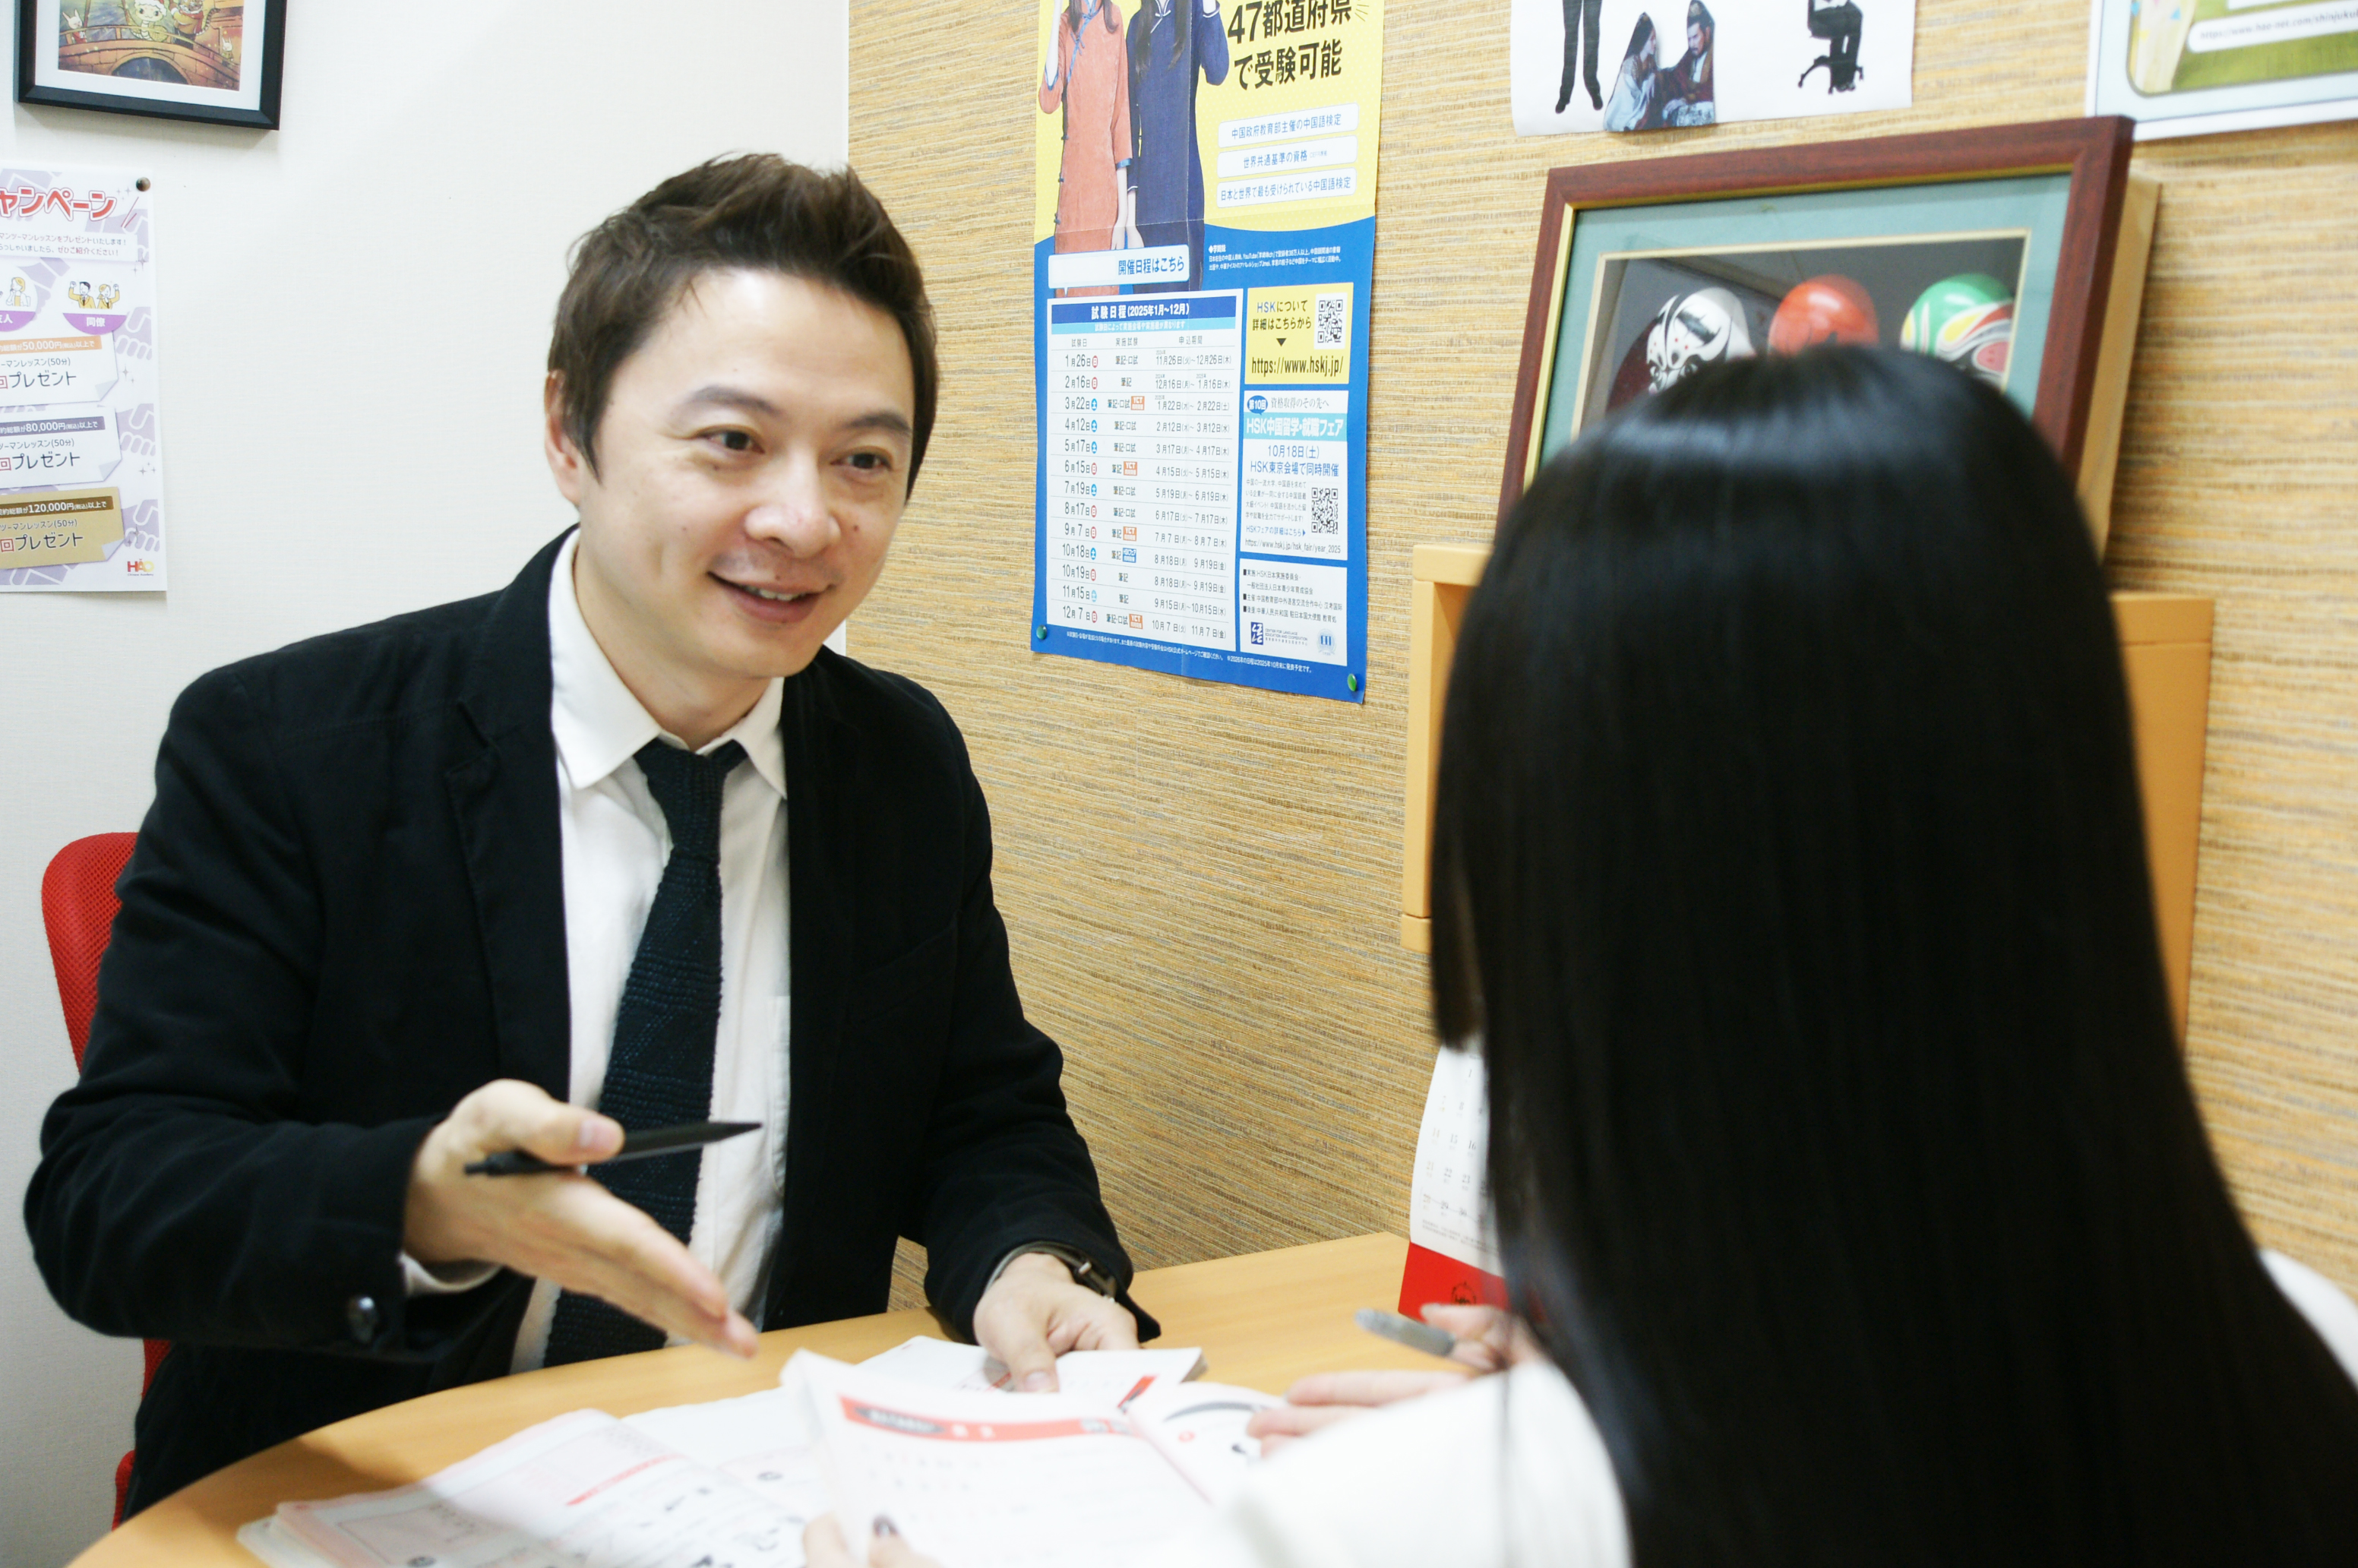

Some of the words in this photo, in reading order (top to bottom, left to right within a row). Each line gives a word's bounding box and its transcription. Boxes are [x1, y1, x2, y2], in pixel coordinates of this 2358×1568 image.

[1228, 0, 1351, 43] 47都道府県
[1234, 39, 1342, 90] で受験可能
[1232, 114, 1342, 139] 中国政府教育部主催の中国語検定
[1244, 150, 1307, 169] 世界共通基準の資格
[1222, 177, 1351, 201] 日本と世界で最も受けられている中国語検定
[1118, 256, 1184, 275] 開催日程はこちら
[1257, 300, 1308, 313] HSKについて
[87, 317, 105, 327] 同僚
[1253, 317, 1312, 330] 詳細はこちらから
[1072, 339, 1087, 347] 試験日
[1116, 337, 1138, 346] 実施試験
[1252, 356, 1343, 377] https://www.hskj.jp/
[1121, 378, 1132, 387] 筆記
[1249, 400, 1266, 409] 第10回
[1271, 397, 1329, 409] 資格取得のその先へ
[0, 451, 80, 471] 回プレゼント
[1112, 464, 1122, 474] 筆記
[1250, 461, 1339, 476] HSK東京会場で同時開催
[1112, 529, 1121, 539] 筆記
[1, 533, 83, 552] 回プレゼント
[1112, 550, 1121, 560] 筆記
[1118, 573, 1128, 583] 筆記
[1119, 594, 1129, 604] 筆記
